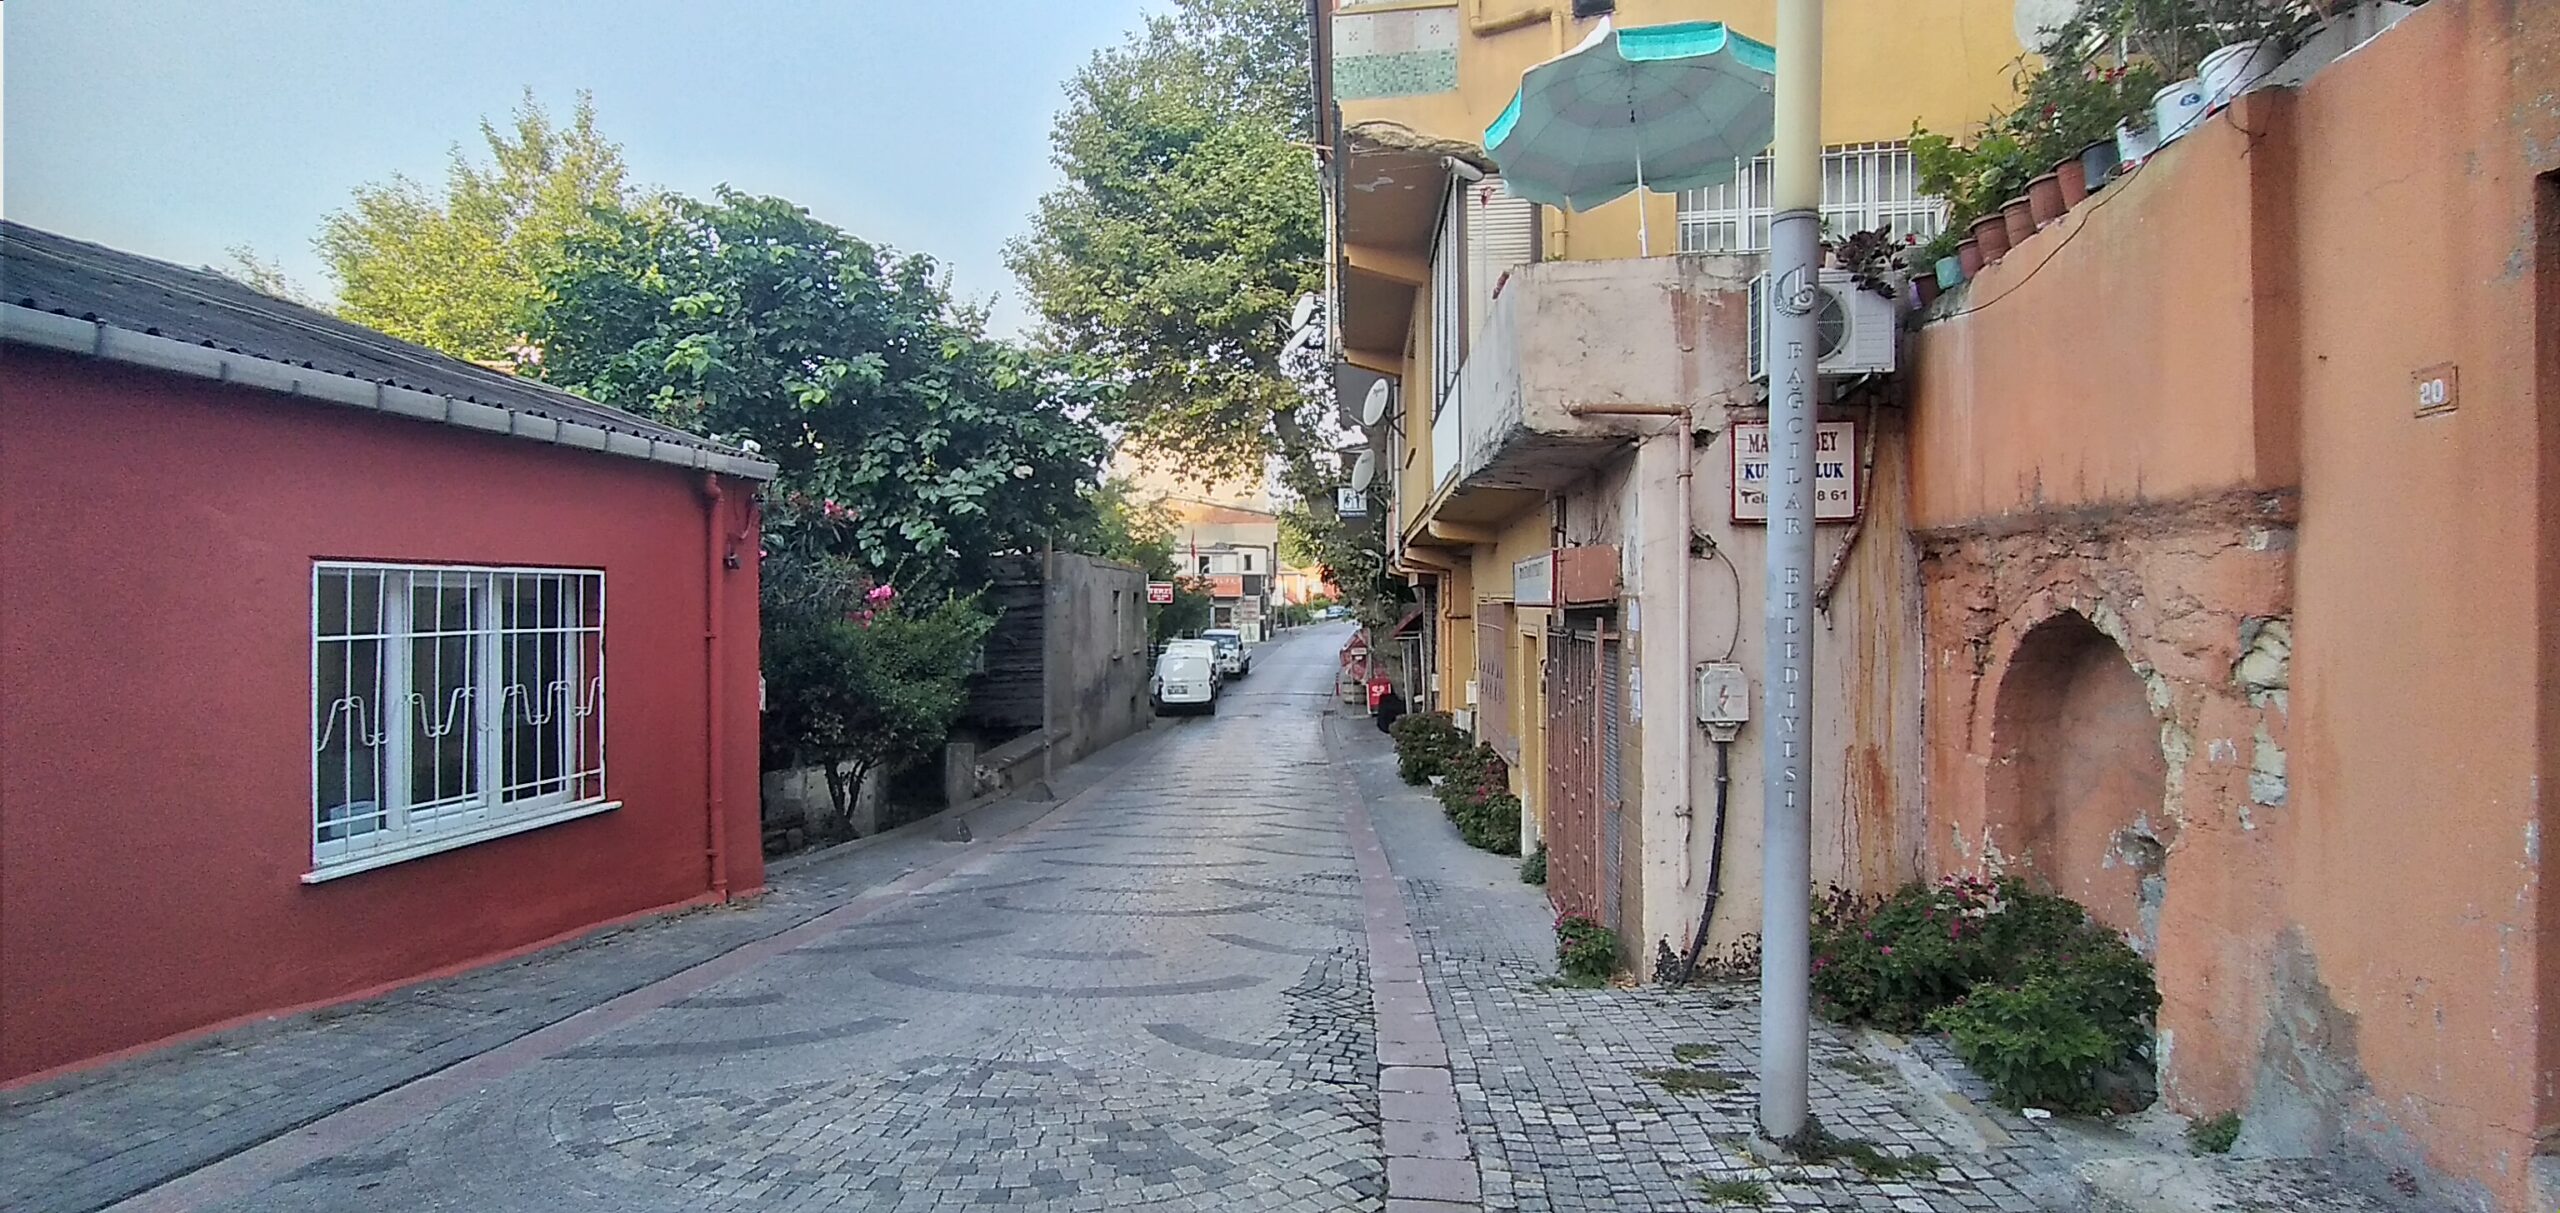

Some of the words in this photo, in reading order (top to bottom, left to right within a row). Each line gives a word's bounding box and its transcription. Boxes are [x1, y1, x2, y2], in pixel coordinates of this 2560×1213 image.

[2420, 379, 2443, 404] 20
[1784, 341, 1804, 535] BAĞCILAR
[1831, 490, 1847, 501] 61
